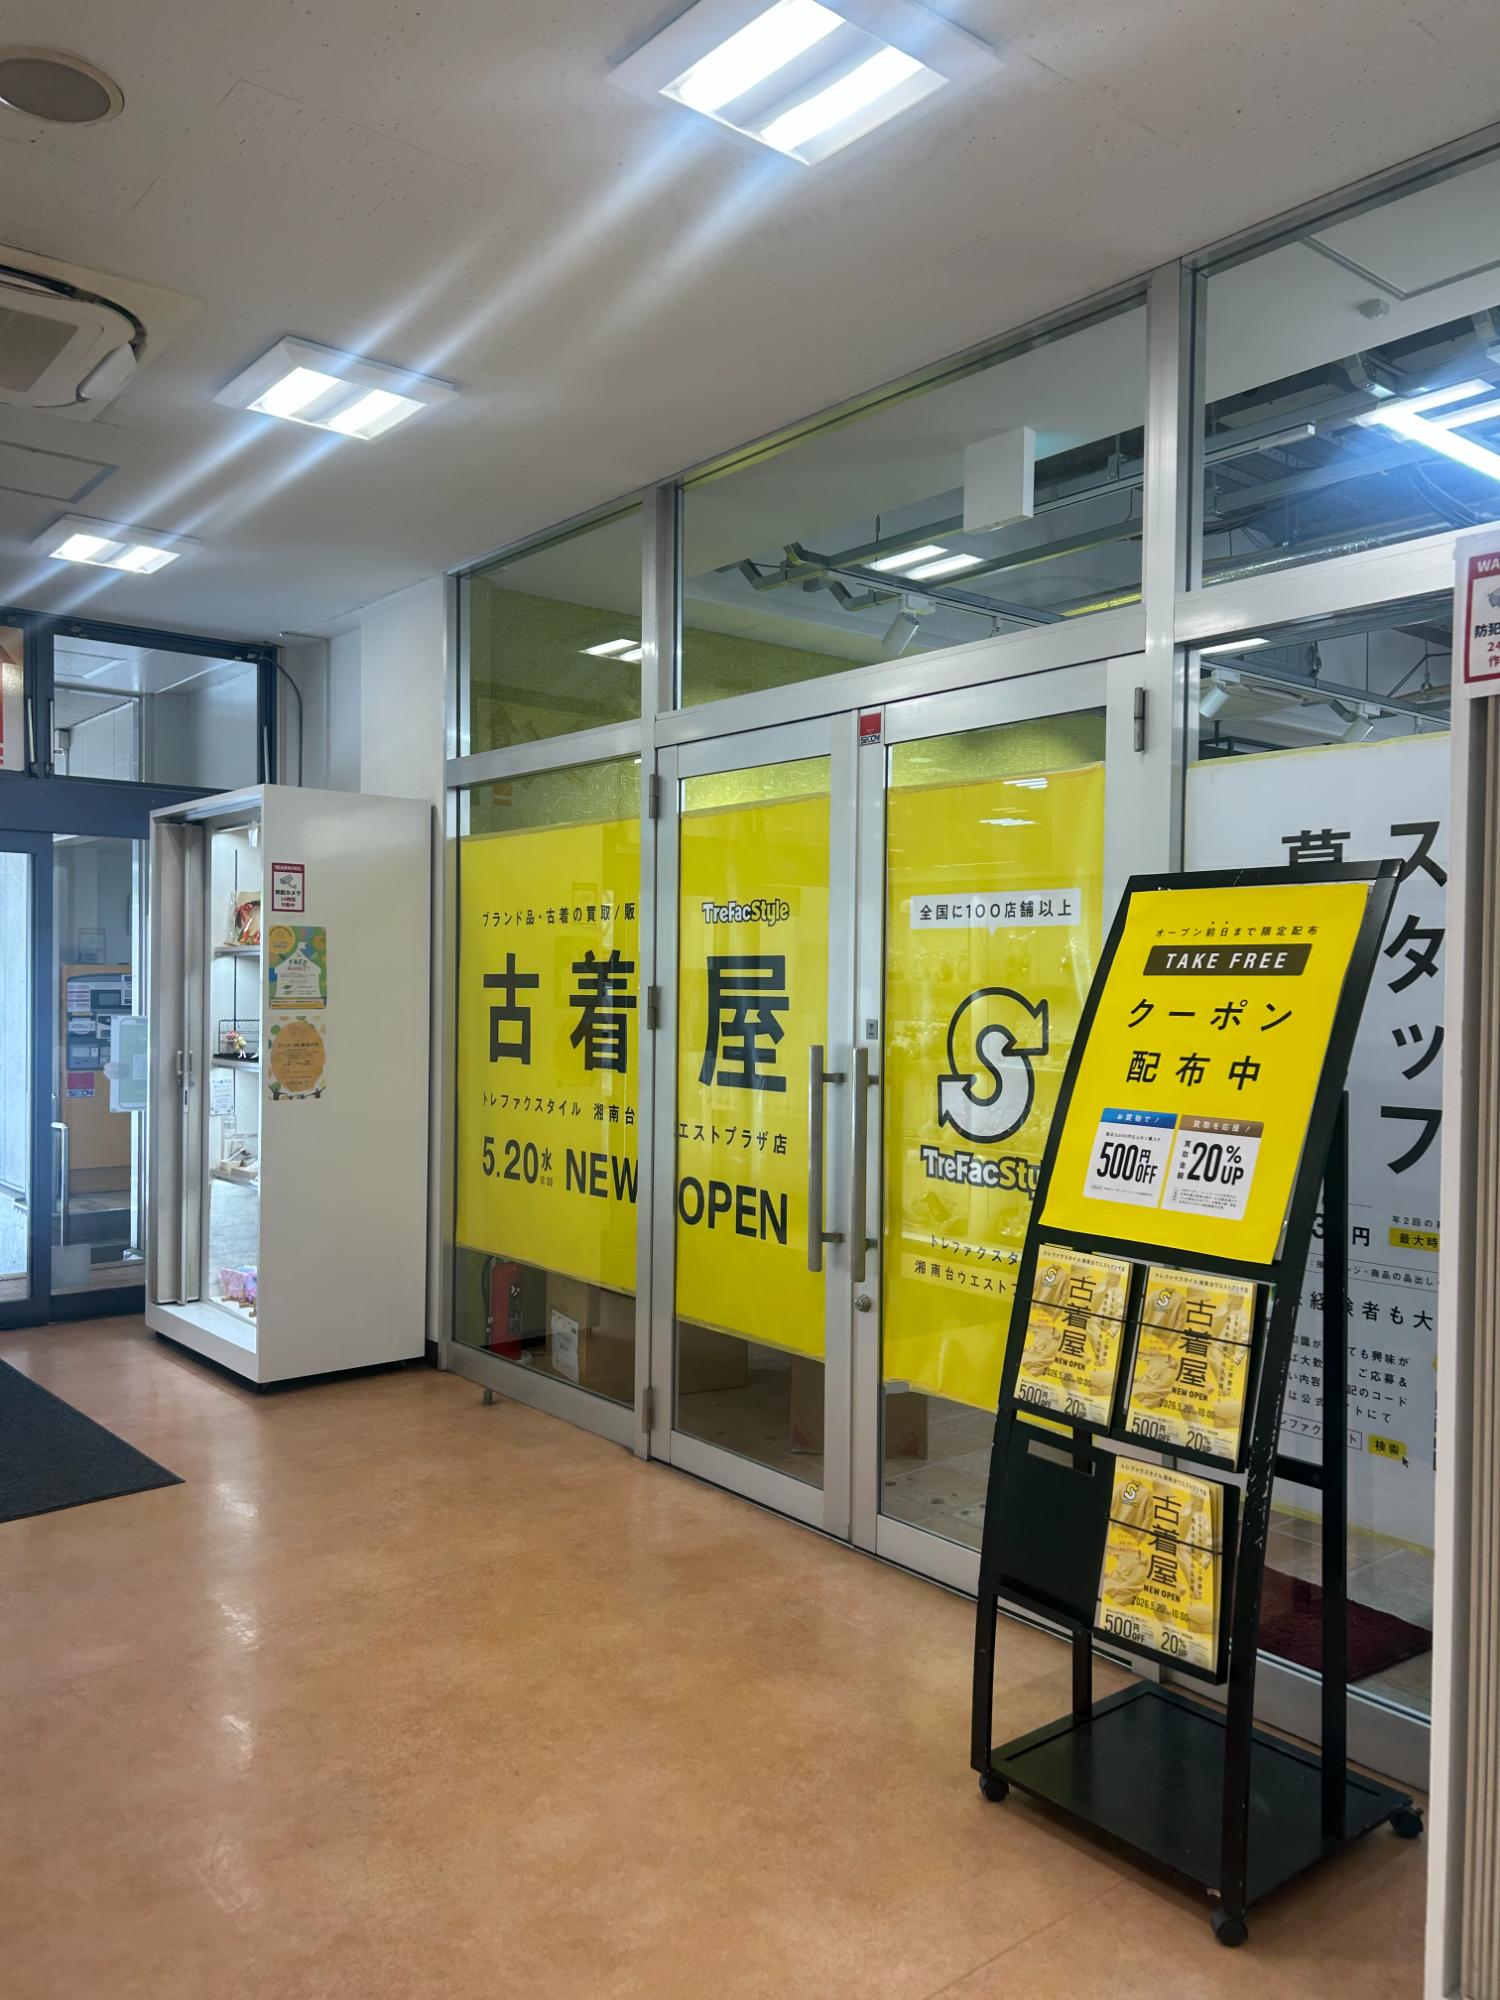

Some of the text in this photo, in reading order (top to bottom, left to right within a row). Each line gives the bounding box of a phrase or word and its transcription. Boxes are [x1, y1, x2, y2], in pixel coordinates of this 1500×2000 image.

[701, 897, 790, 927] TreFacStyle
[919, 898, 1073, 921] 全国に100店舗以上
[1155, 922, 1319, 938] オープン前日まで限定配布
[1166, 952, 1288, 969] TAKE FREE
[1381, 820, 1449, 1175] スタッフ
[1127, 998, 1293, 1032] クーポン
[1126, 1049, 1262, 1091] 配布中
[1220, 1165, 1244, 1186] UP
[565, 1148, 639, 1204] NEW
[678, 1175, 788, 1245] OPEN
[1391, 1215, 1440, 1230] 年2回の
[1058, 1275, 1097, 1359] 古着屋
[1175, 1299, 1217, 1389] 古着屋
[1054, 1356, 1086, 1371] NEW OPEN
[1171, 1386, 1209, 1402] NEW OPEN
[1375, 1439, 1400, 1456] 検索
[1146, 1495, 1182, 1589] 古着屋
[1143, 1583, 1181, 1603] NEW OPEN
